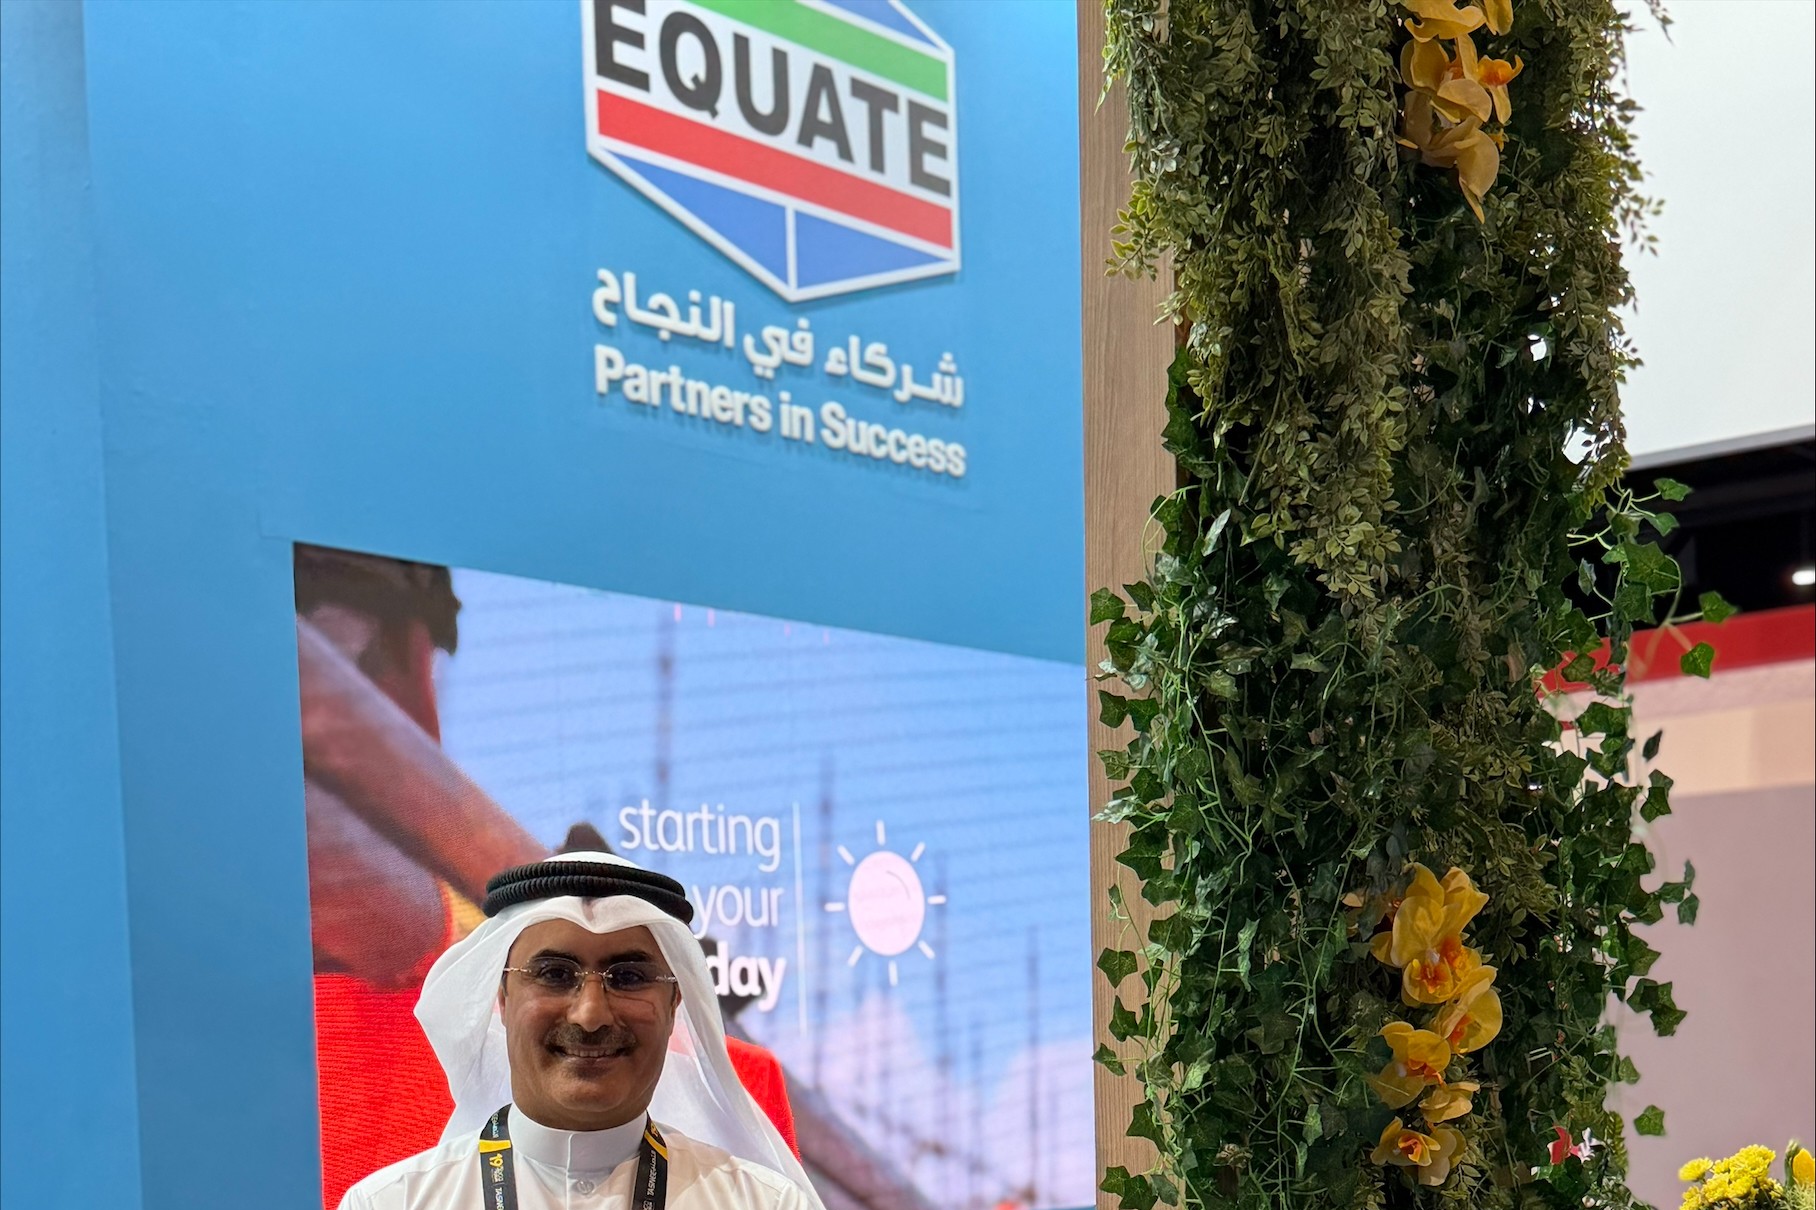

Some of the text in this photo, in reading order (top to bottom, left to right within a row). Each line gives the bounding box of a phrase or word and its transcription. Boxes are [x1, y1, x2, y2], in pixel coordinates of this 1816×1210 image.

[594, 0, 952, 197] EQUATE
[591, 267, 965, 407] شركاء في النجاح
[594, 344, 967, 477] Partners in Success
[619, 798, 781, 874] starting
[691, 884, 784, 940] your
[706, 940, 787, 1012] day
[489, 1153, 503, 1167] 19
